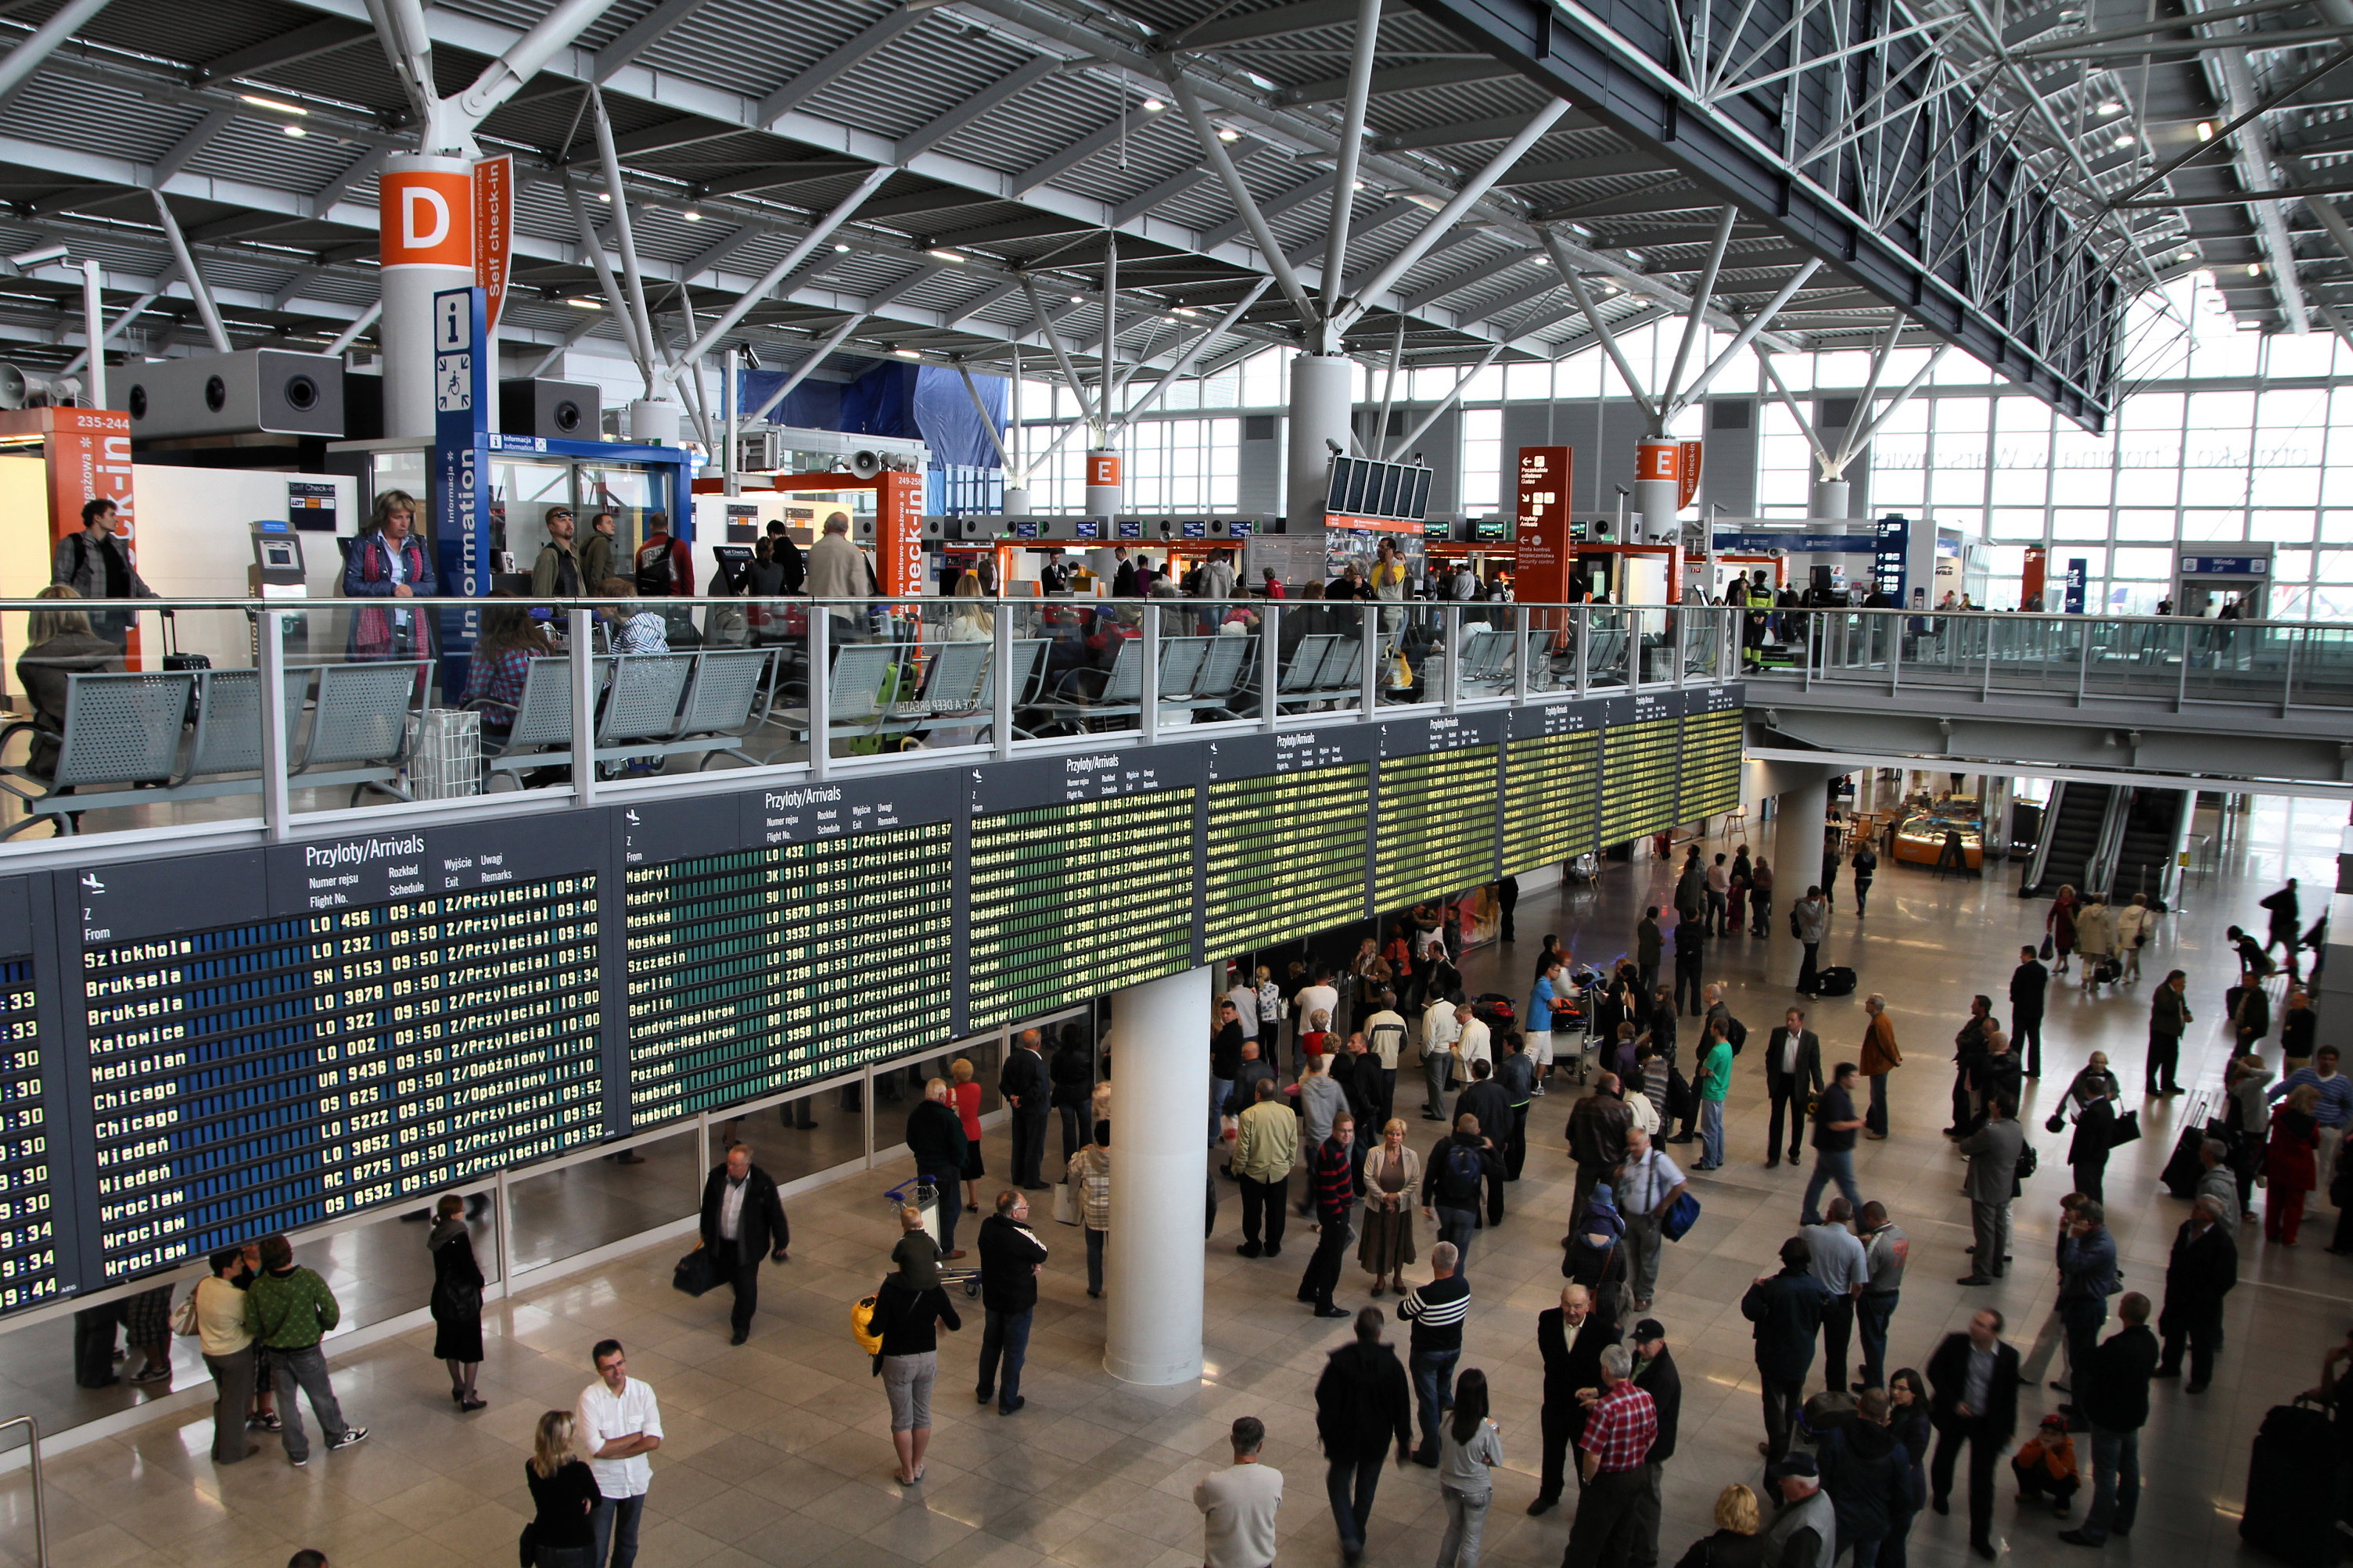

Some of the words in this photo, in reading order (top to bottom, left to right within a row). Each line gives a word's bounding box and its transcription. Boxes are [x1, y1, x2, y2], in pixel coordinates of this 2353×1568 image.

[489, 164, 499, 251] check-in
[402, 187, 450, 249] D
[490, 258, 500, 296] Self
[77, 415, 130, 429] 235-244
[505, 443, 534, 451] Information
[1657, 450, 1672, 475] E
[1097, 461, 1112, 482] E
[898, 477, 921, 486] 249-258
[462, 449, 476, 638] Inormation
[1066, 754, 1119, 773] Przyloty/Arrivals
[765, 785, 842, 810] Przyloty/Arrivals
[972, 791, 975, 799] Z
[1067, 791, 1077, 799] Flight
[1101, 785, 1118, 795] Schedule
[852, 805, 871, 816] Wyjście
[878, 802, 893, 813] Uwagi
[1101, 798, 1122, 811] 10:05
[767, 816, 785, 827] Numer
[785, 814, 798, 826] rejsu
[853, 819, 862, 829] Exit
[878, 816, 898, 826] Remarks
[1079, 820, 1092, 831] 955
[767, 831, 781, 842] Flight
[781, 830, 791, 840] No.
[817, 823, 840, 834] Schedule
[627, 835, 631, 846] Z
[306, 834, 425, 867] Przyloty/Arrivals
[626, 866, 670, 884] Madryt
[766, 849, 779, 862] LO
[785, 845, 804, 859] 432
[817, 839, 846, 855] 09:55
[925, 823, 952, 838] 09:57
[627, 851, 642, 862] From
[444, 857, 472, 872] Wyjście
[480, 852, 503, 867] Uwagi
[389, 864, 419, 878] Rozkład
[481, 870, 512, 884] Remarks
[309, 877, 337, 889] Numer
[339, 874, 358, 886] rejsu
[390, 881, 424, 896] Schedule
[445, 877, 458, 888] Exit
[310, 895, 333, 910] Flight
[334, 892, 348, 905] No.
[84, 907, 92, 920] Z
[627, 911, 671, 929] Moskwa
[84, 939, 192, 969] Sztokholm
[311, 916, 331, 934] LO
[341, 911, 370, 928] 456
[390, 901, 436, 920] 09:40
[557, 877, 597, 895] 09:47
[84, 928, 110, 941] From
[627, 952, 686, 974] Szczecin
[88, 996, 183, 1026] Bruksela
[314, 968, 333, 985] SN
[343, 960, 383, 978] 5153
[392, 950, 438, 971] 09:50
[559, 922, 598, 941] 09:40
[86, 969, 181, 998] Bruksela
[629, 1005, 735, 1039] Londyn-Heathrow
[767, 993, 781, 1006] LO
[786, 987, 806, 1001] 286
[817, 978, 847, 996] 10:00
[90, 1024, 185, 1055] Katowice
[92, 1053, 186, 1083] Mediolan
[93, 1082, 177, 1111] Chicago
[318, 1046, 336, 1063] LO
[347, 1037, 376, 1056] 002
[320, 1095, 339, 1113] OS
[349, 1087, 379, 1106] 625
[397, 1072, 444, 1095] 09:50
[555, 1037, 594, 1057] 11:10
[632, 1102, 682, 1126] Hamburg
[768, 1074, 781, 1088] LH
[787, 1064, 812, 1082] 2250
[818, 1053, 848, 1073] 10:05
[925, 1025, 951, 1043] 10:09
[95, 1109, 178, 1139] Chicago
[325, 1196, 345, 1214] OS
[354, 1183, 392, 1207] 8532
[401, 1170, 447, 1193] 09:50
[564, 1124, 603, 1146] 09:52
[60, 1284, 77, 1294] AEG
